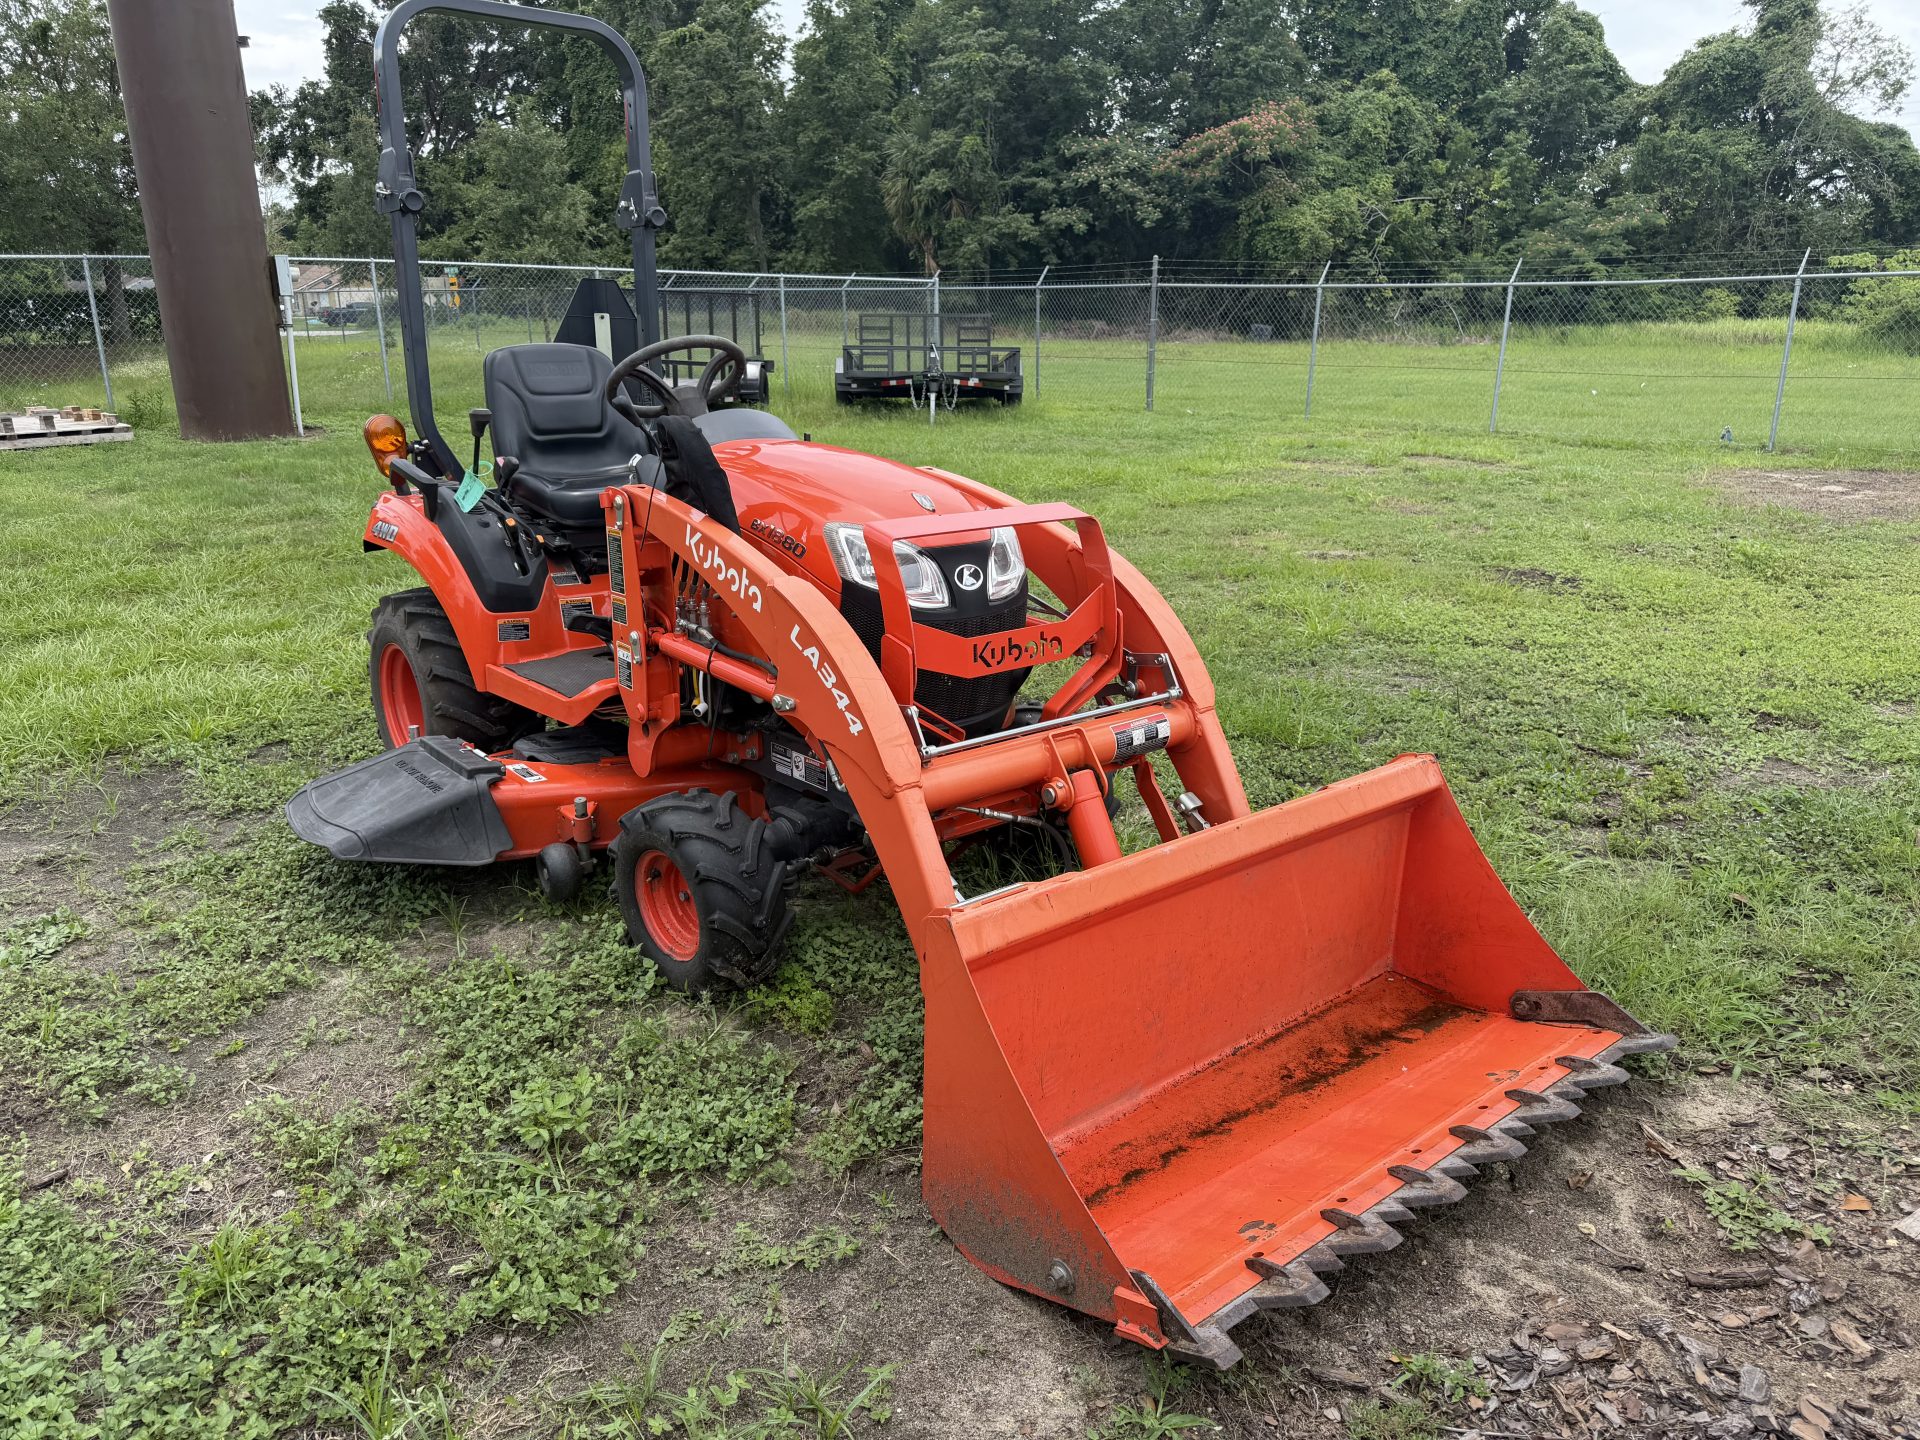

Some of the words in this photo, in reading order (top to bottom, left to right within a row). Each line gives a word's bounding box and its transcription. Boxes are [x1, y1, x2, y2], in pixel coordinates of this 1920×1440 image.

[371, 520, 399, 543] 4WD
[750, 518, 807, 559] BX1880
[685, 524, 762, 613] Kubota
[972, 631, 1063, 668] Kubota
[790, 623, 864, 736] LA344
